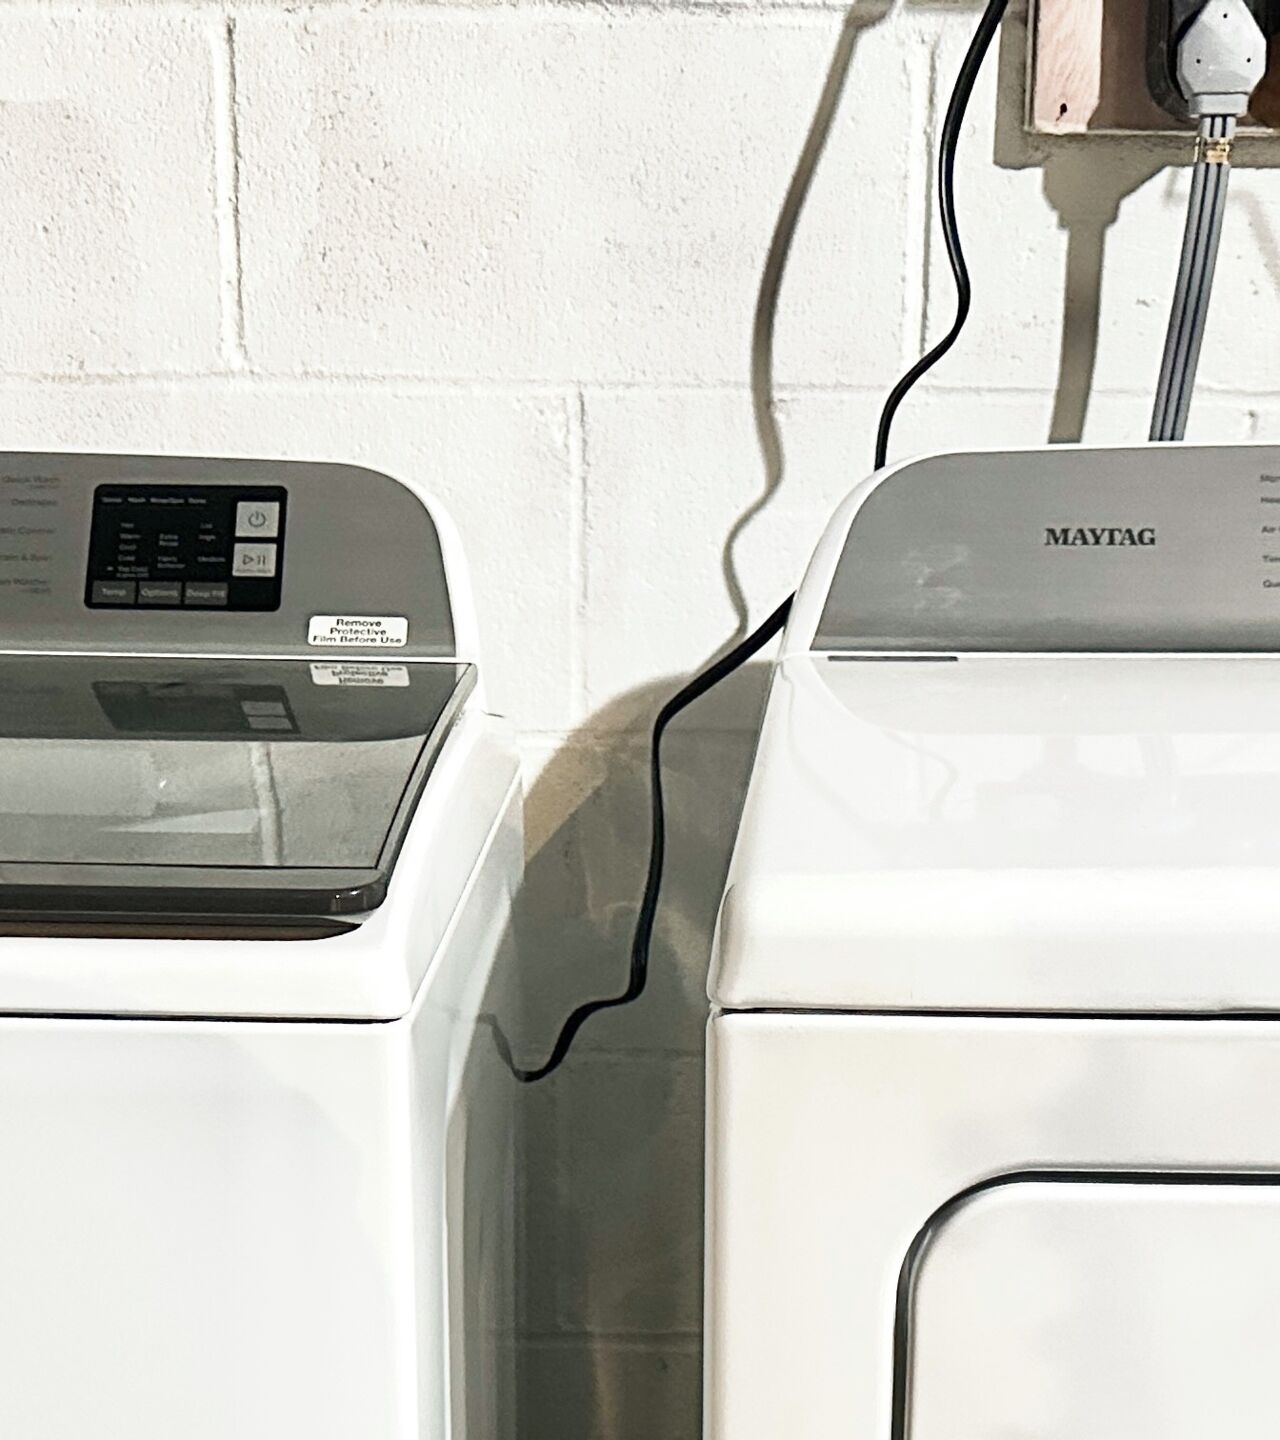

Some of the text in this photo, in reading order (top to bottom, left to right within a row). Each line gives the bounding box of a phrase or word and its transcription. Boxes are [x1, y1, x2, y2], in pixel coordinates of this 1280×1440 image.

[1044, 528, 1156, 547] MAYTAG
[336, 618, 382, 628] Remove
[329, 627, 386, 636] Protective
[312, 635, 402, 644] Film Before Use
